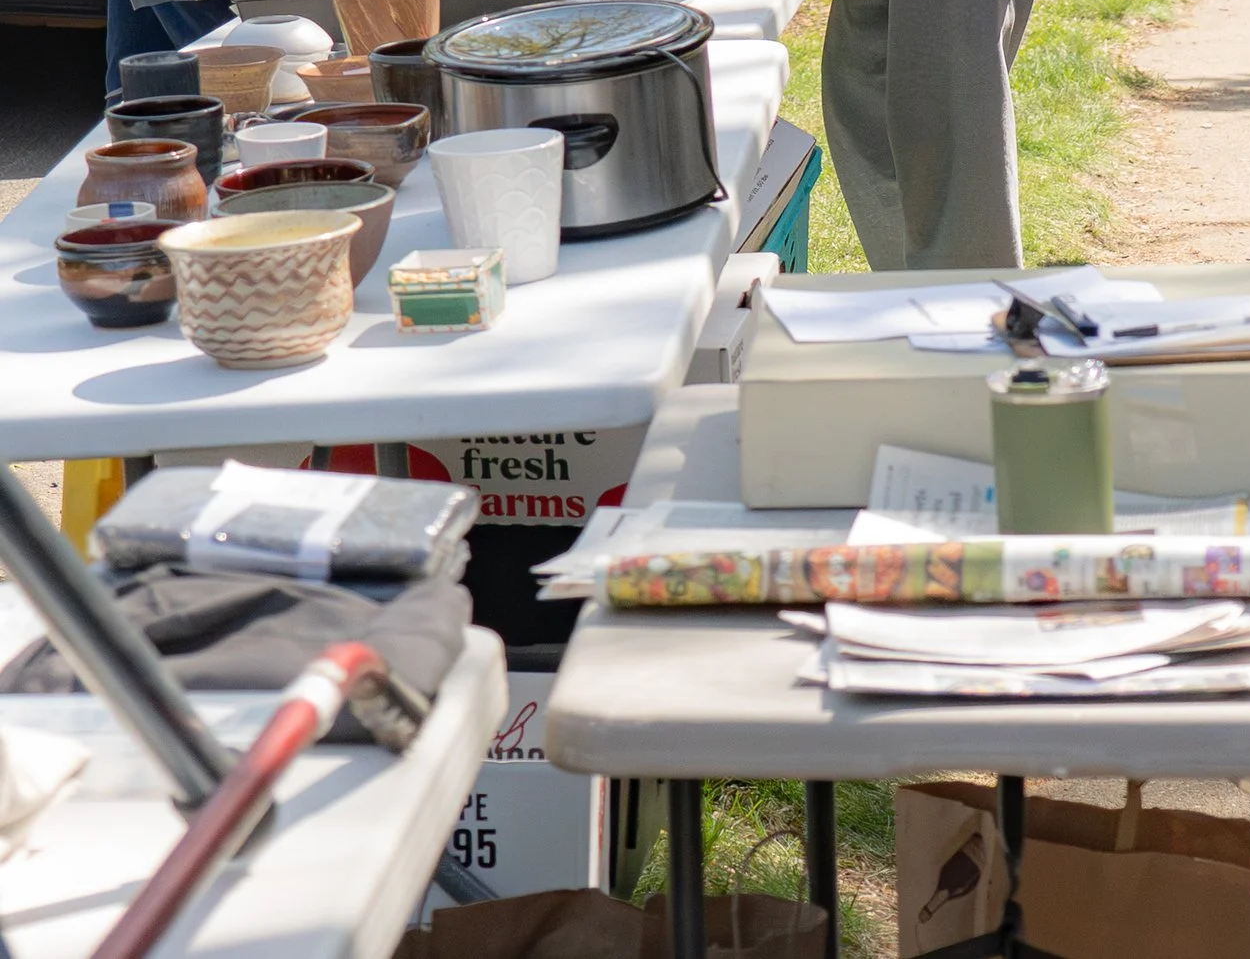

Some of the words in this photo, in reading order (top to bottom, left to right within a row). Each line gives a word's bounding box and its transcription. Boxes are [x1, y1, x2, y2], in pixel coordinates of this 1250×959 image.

[461, 430, 596, 446] ure
[460, 448, 570, 481] fresh
[468, 484, 586, 518] arms
